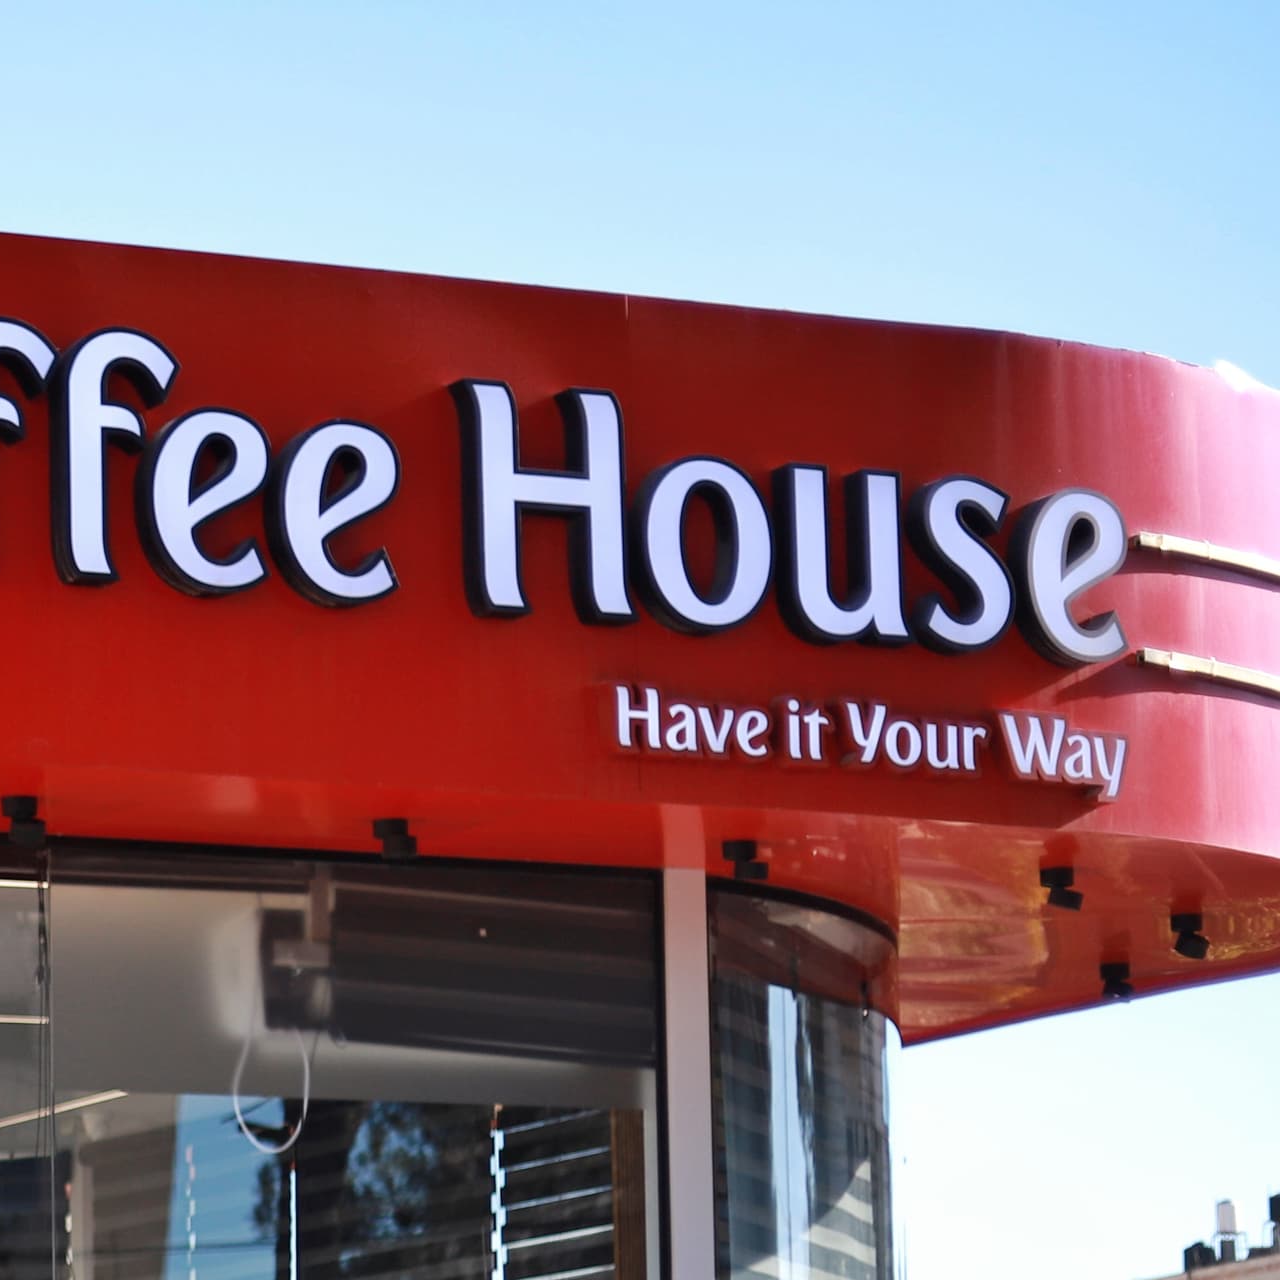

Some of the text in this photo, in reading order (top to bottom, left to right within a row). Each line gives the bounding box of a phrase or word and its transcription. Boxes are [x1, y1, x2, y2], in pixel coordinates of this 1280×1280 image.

[450, 378, 1128, 664] House
[616, 686, 1127, 799] Have it Your Way
